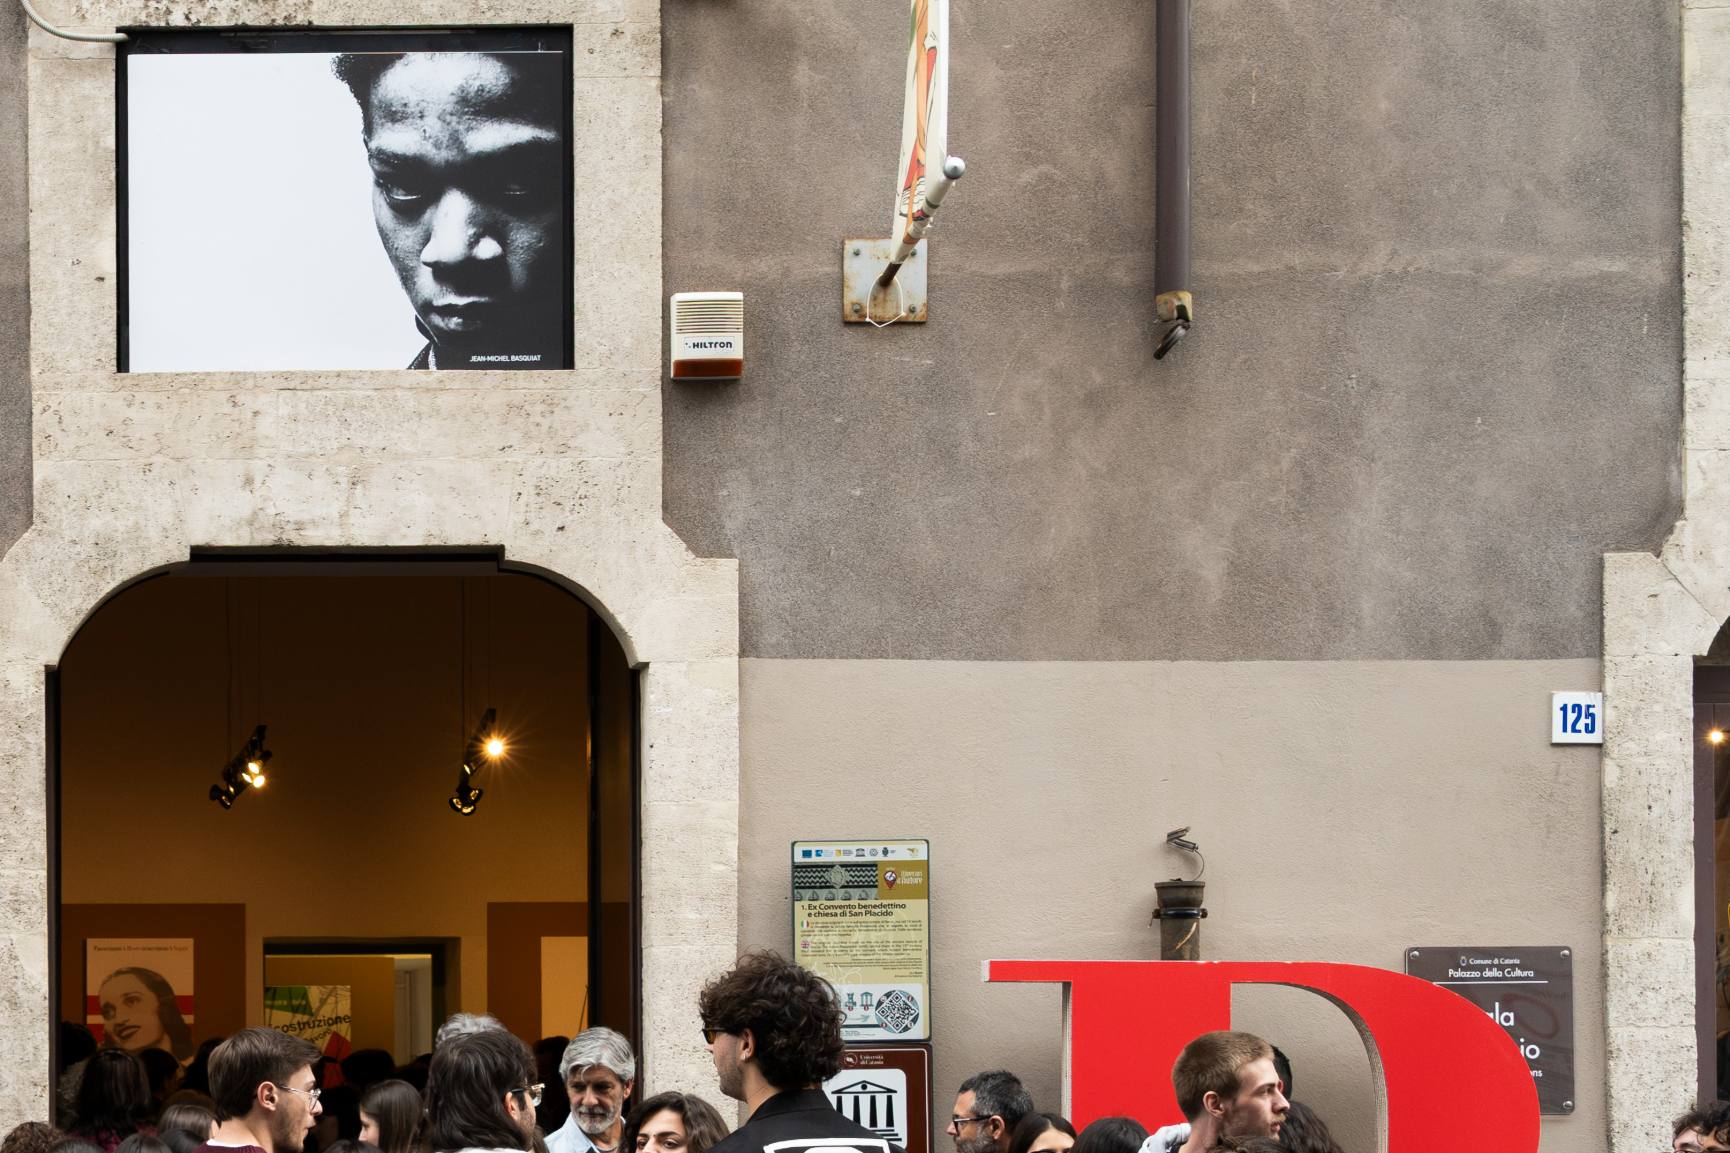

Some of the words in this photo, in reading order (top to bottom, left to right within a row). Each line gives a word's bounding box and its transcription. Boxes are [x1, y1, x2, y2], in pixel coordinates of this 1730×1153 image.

[510, 354, 541, 362] BASQUIAT
[1559, 703, 1596, 734] 125
[807, 903, 818, 911] Ex
[818, 903, 857, 911] Convento
[857, 902, 907, 910] benedettino
[813, 910, 838, 918] chiesa
[864, 909, 894, 917] Placido
[1469, 957, 1492, 965] Comune
[1493, 957, 1499, 965] di
[1499, 957, 1520, 965] Catania
[1448, 968, 1481, 978] Palazzo
[1482, 968, 1503, 978] della
[1504, 968, 1534, 978] Cultura
